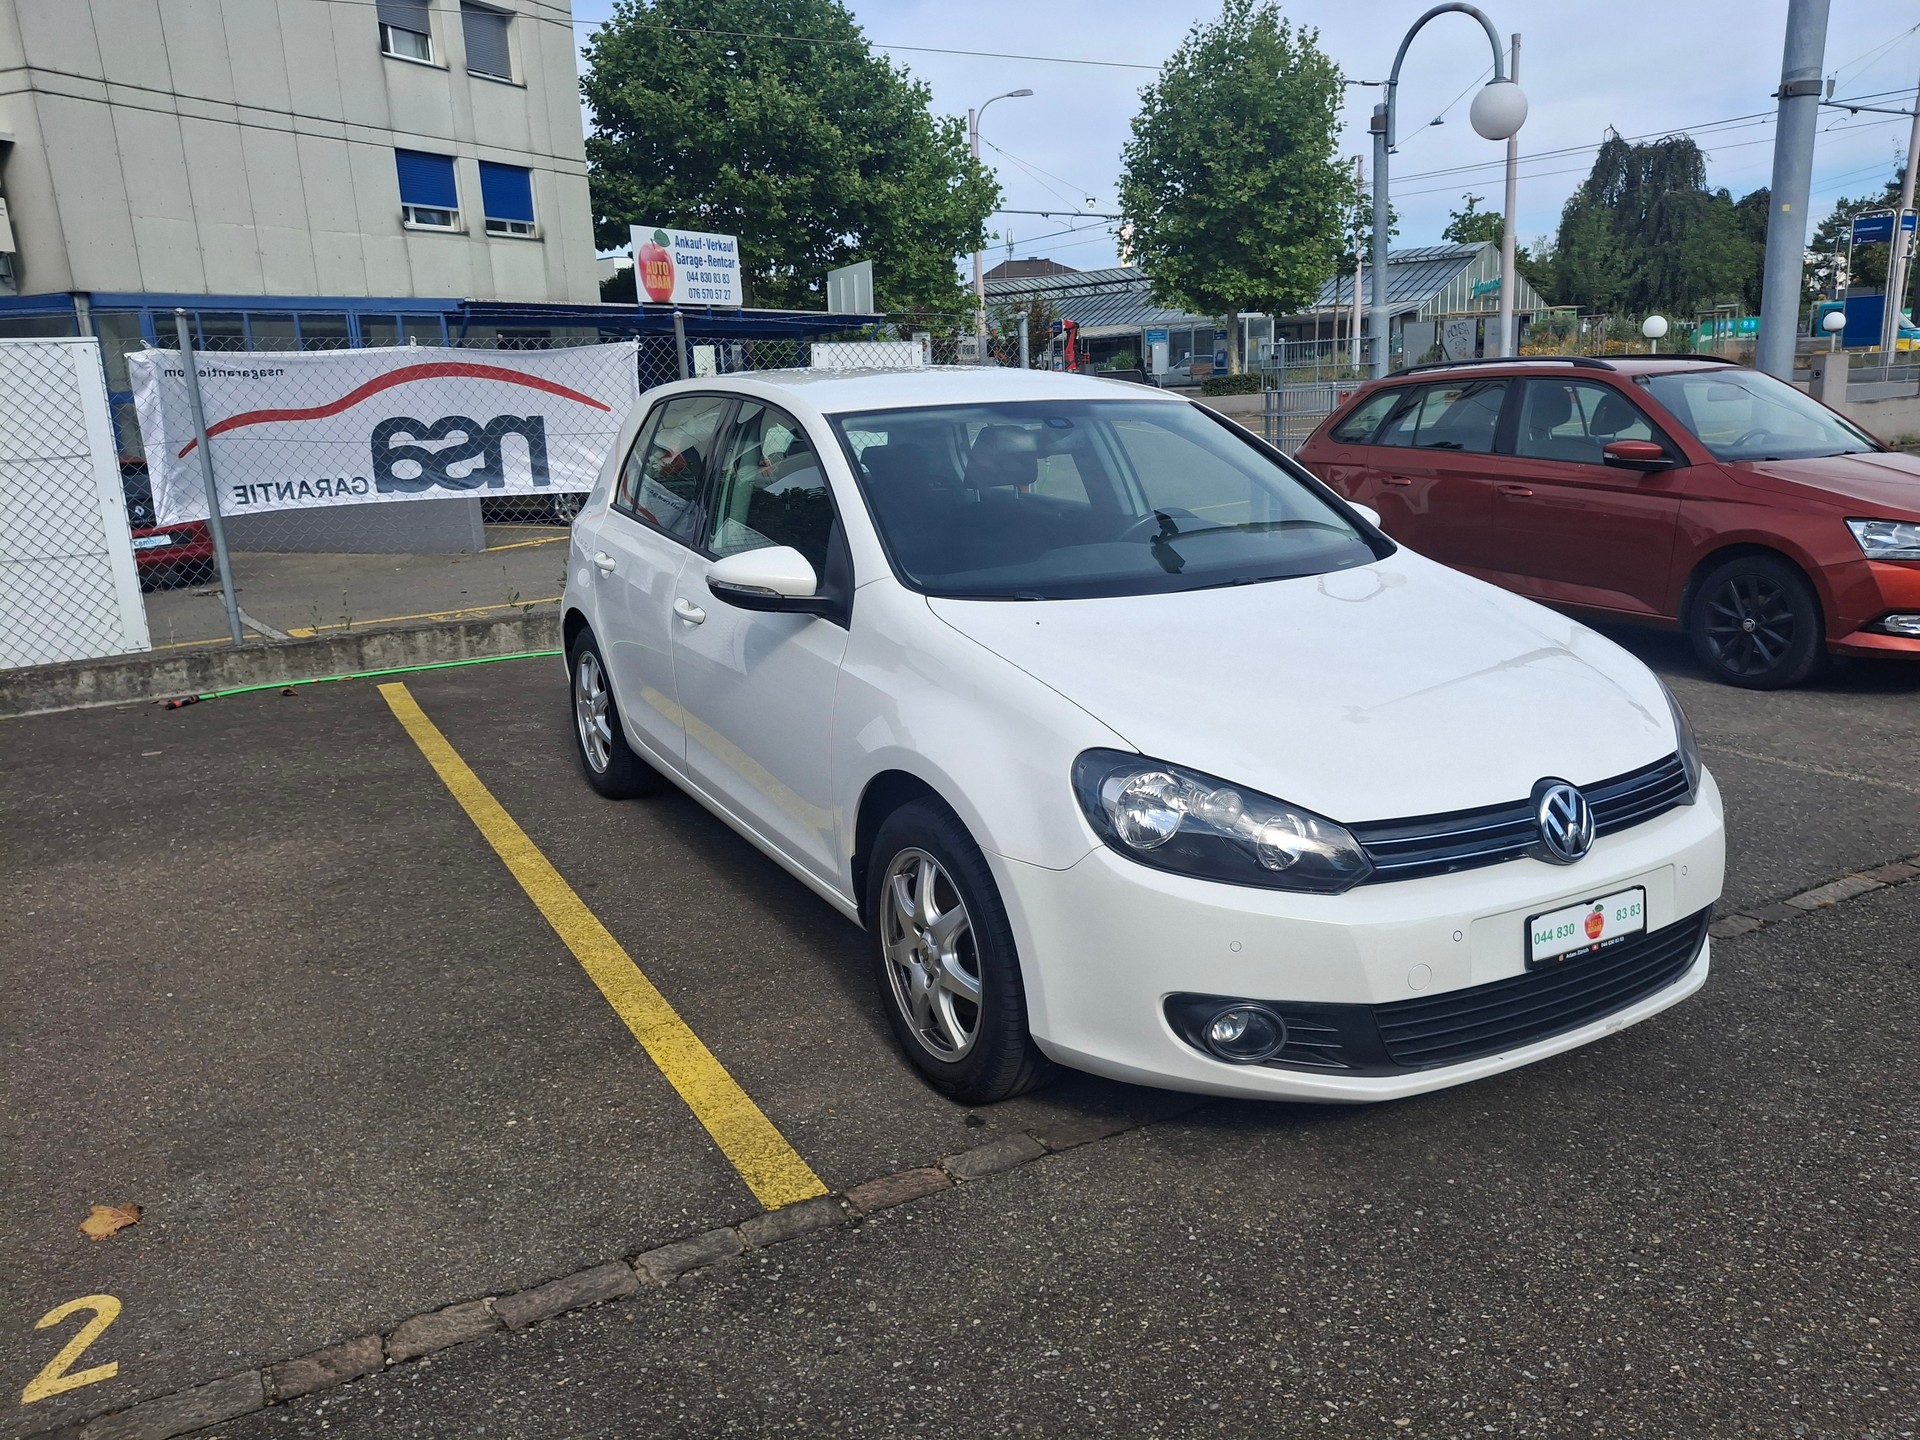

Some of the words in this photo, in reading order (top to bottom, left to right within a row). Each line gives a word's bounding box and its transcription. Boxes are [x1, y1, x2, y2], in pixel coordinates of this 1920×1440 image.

[646, 260, 669, 275] AUTO
[646, 275, 671, 289] ADAM
[687, 271, 699, 282] 044
[700, 272, 712, 283] 830
[713, 273, 721, 284] 83
[722, 273, 730, 284] 83
[689, 288, 700, 298] 076
[702, 289, 713, 299] 570
[715, 289, 722, 300] 57
[724, 290, 731, 300] 27
[1616, 908, 1628, 921] 83
[1630, 903, 1641, 917] 83
[1534, 928, 1553, 945] 044
[1557, 922, 1575, 939] 830
[20, 1294, 122, 1404] 2
